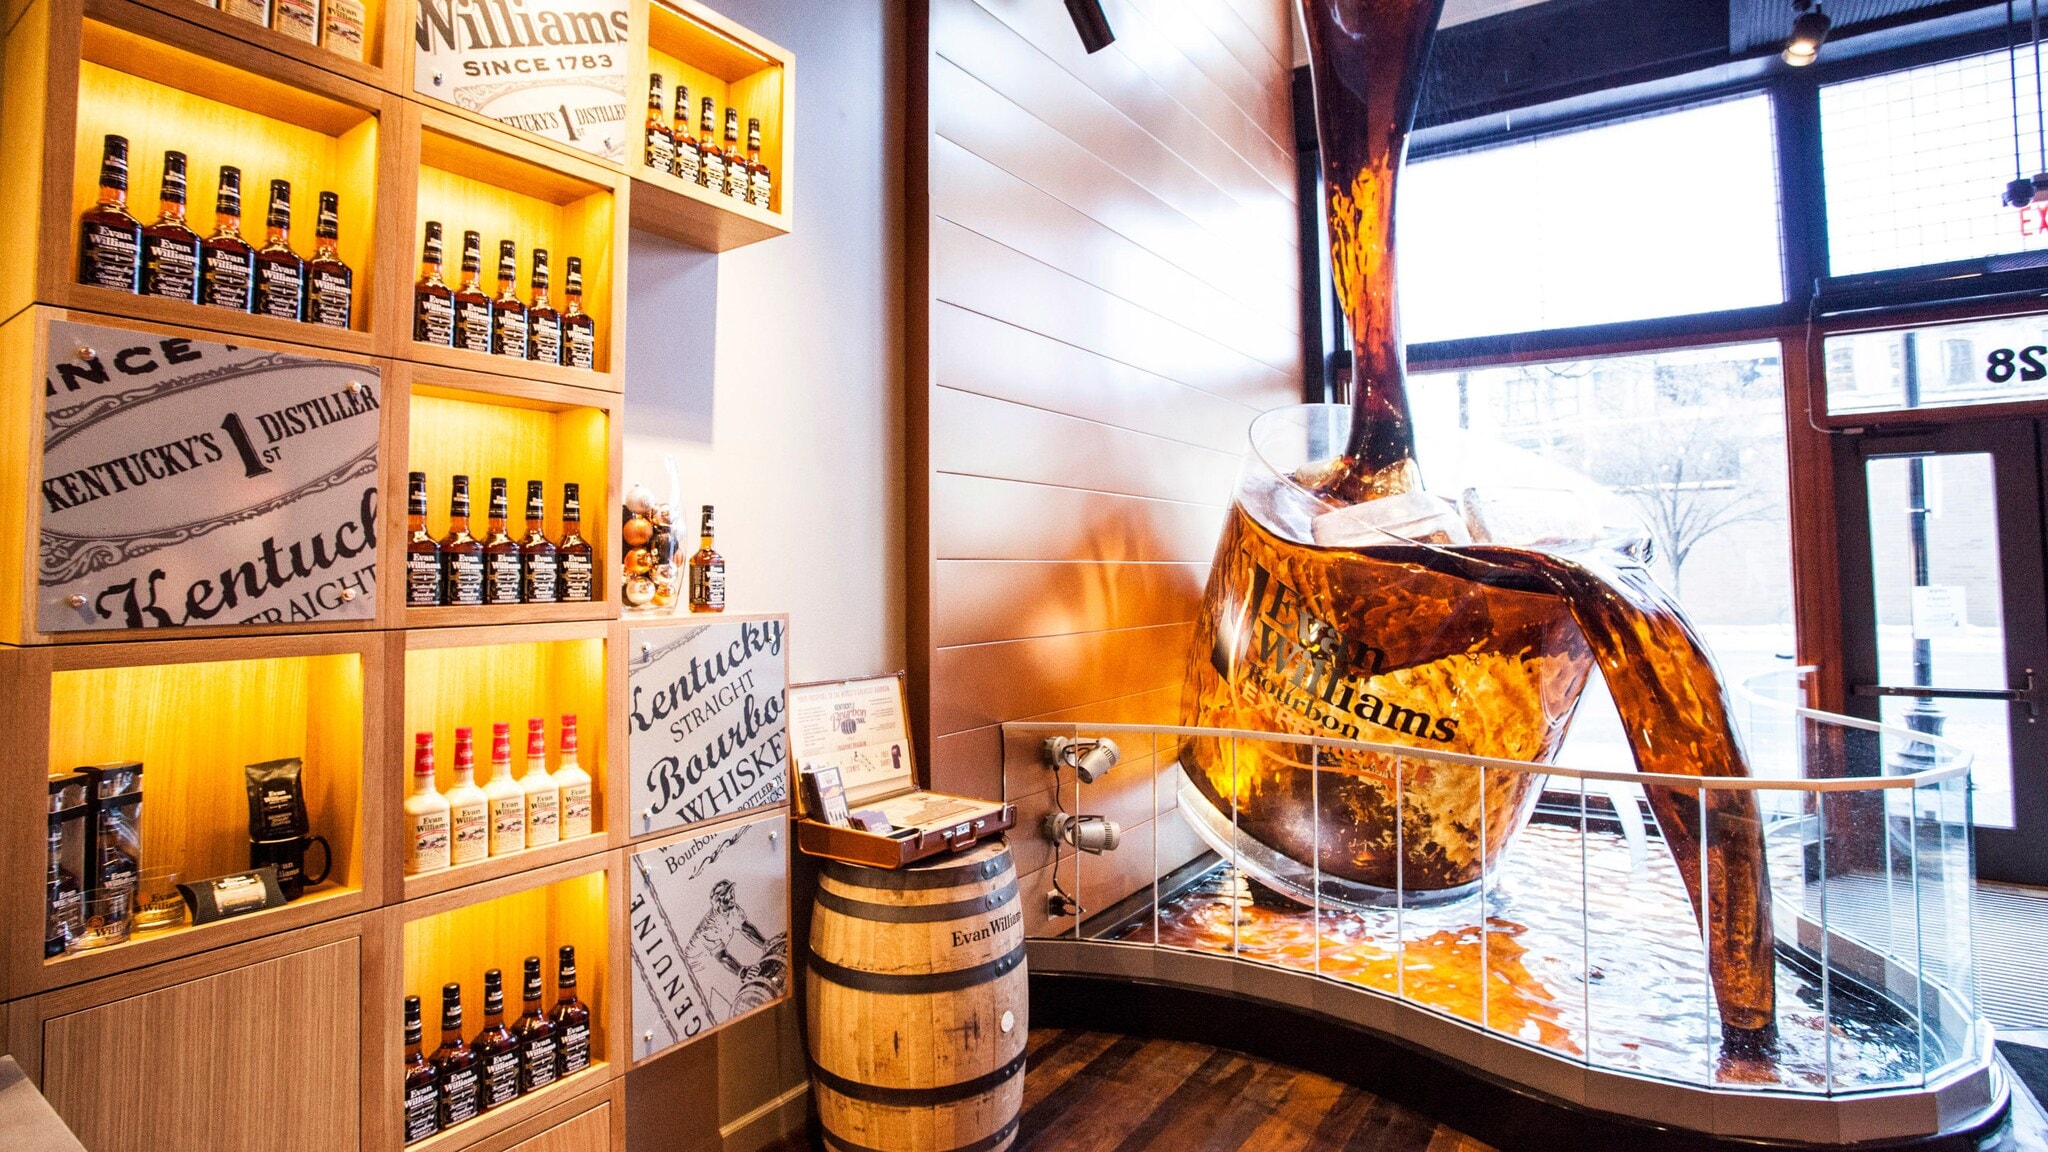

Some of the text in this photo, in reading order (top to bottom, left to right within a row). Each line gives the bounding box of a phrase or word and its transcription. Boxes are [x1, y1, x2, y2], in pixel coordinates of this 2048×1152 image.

[416, 0, 628, 51] Williams
[463, 54, 613, 76] SINCE 1783
[99, 225, 132, 240] Evan
[89, 233, 140, 252] Williams
[160, 238, 191, 253] Evan
[150, 246, 200, 263] Williams
[216, 249, 245, 264] Evan
[207, 257, 251, 274] Williams
[270, 262, 297, 275] Evan
[262, 269, 303, 285] Williams
[322, 272, 346, 285] Evan
[314, 279, 351, 294] Williams
[42, 431, 223, 514] KENTUCKY'S
[255, 384, 380, 444] DISTILLER
[413, 553, 435, 562] Evan
[458, 553, 479, 562] Evan
[497, 553, 517, 562] Evan
[534, 554, 553, 563] Evan
[568, 554, 587, 563] Evan
[1266, 578, 1386, 676] Evan
[1260, 619, 1459, 743] Williams
[670, 669, 755, 743] STRAIGHT
[1250, 662, 1360, 741] Bourbon
[422, 816, 443, 825] Evan
[462, 809, 481, 818] Evan
[952, 928, 990, 947] Evan
[630, 893, 702, 1038] GENUINE
[561, 1029, 590, 1044] Williams
[566, 1024, 585, 1035] Evan
[526, 1043, 556, 1058] Williams
[531, 1038, 551, 1049] Evan
[487, 1057, 519, 1074] Williams
[493, 1052, 513, 1064] Evan
[444, 1074, 478, 1092] Williams
[451, 1069, 472, 1082] Evan
[405, 1090, 438, 1108] Williams
[410, 1085, 432, 1099] Evan
